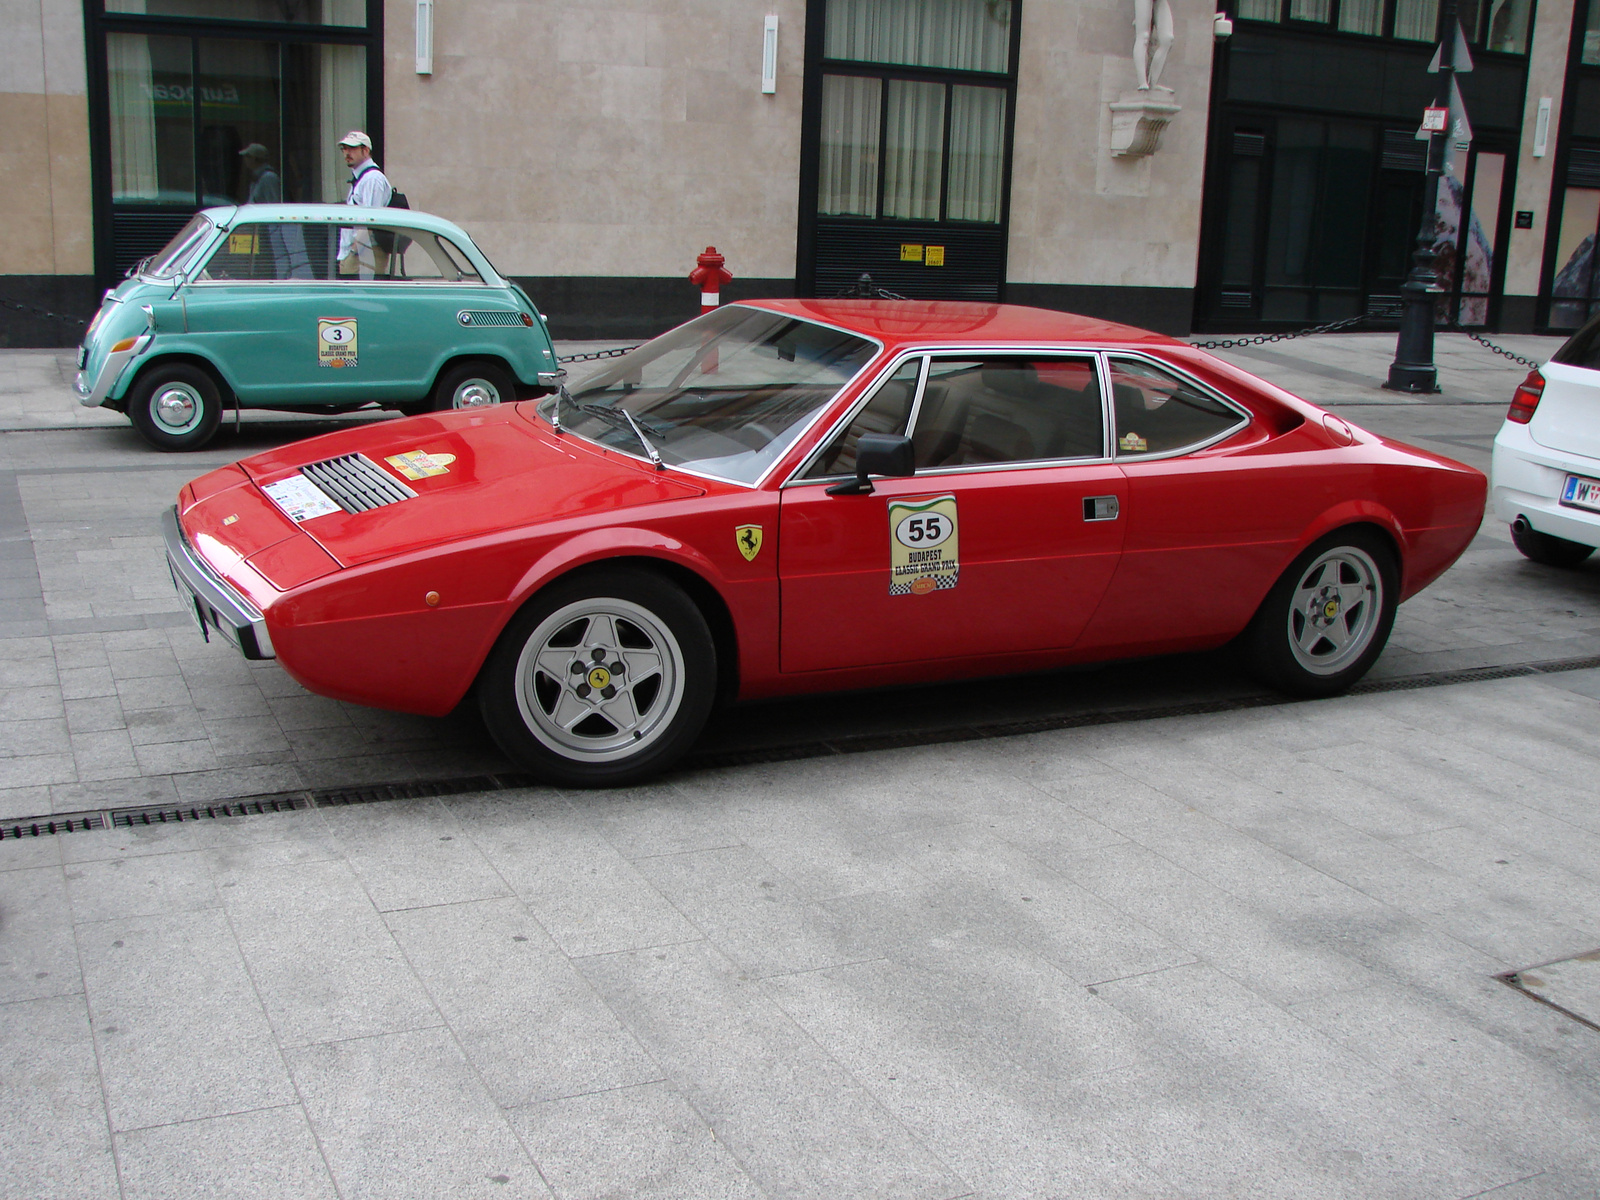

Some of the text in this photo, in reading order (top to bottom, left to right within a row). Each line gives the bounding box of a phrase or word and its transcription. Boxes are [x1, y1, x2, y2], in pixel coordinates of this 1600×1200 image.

[334, 330, 342, 340] 3
[1577, 483, 1591, 501] W
[908, 517, 941, 542] 55
[908, 549, 942, 563] BUDAPEST
[895, 559, 956, 576] CLASSIC GRAND PRIX
